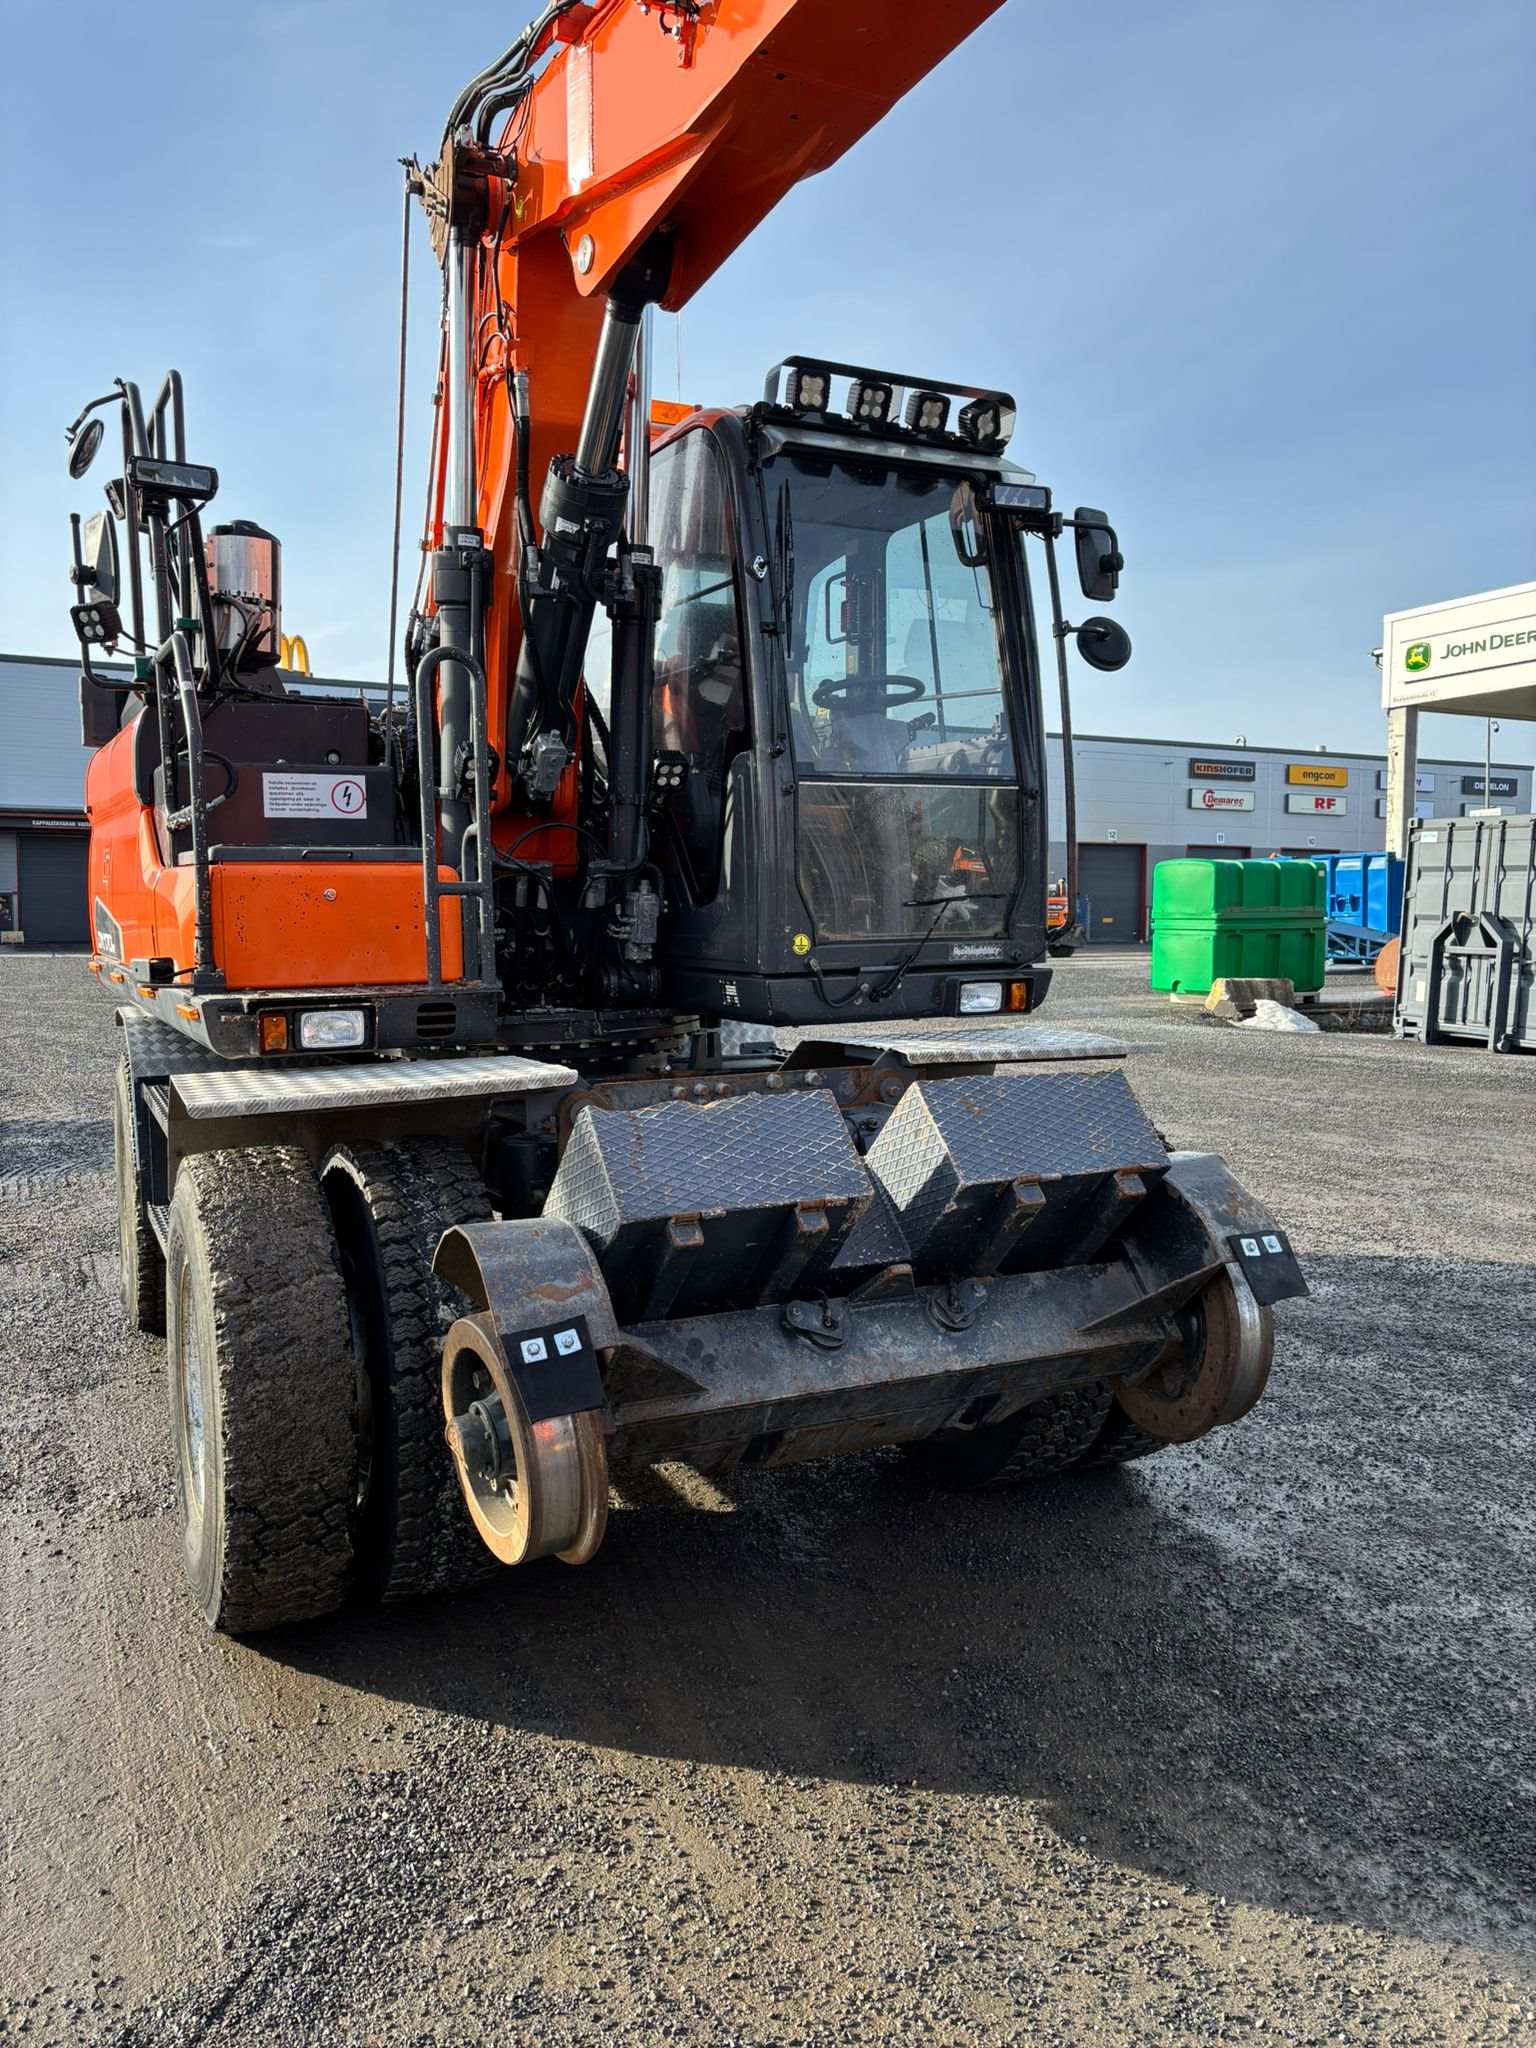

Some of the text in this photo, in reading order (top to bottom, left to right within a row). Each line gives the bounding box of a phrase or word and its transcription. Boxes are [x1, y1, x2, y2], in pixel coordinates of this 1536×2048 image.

[1440, 640, 1487, 659] JOHN
[1196, 764, 1252, 775] KINSHOFER
[1302, 770, 1336, 781] engcon
[1314, 797, 1336, 809] RF
